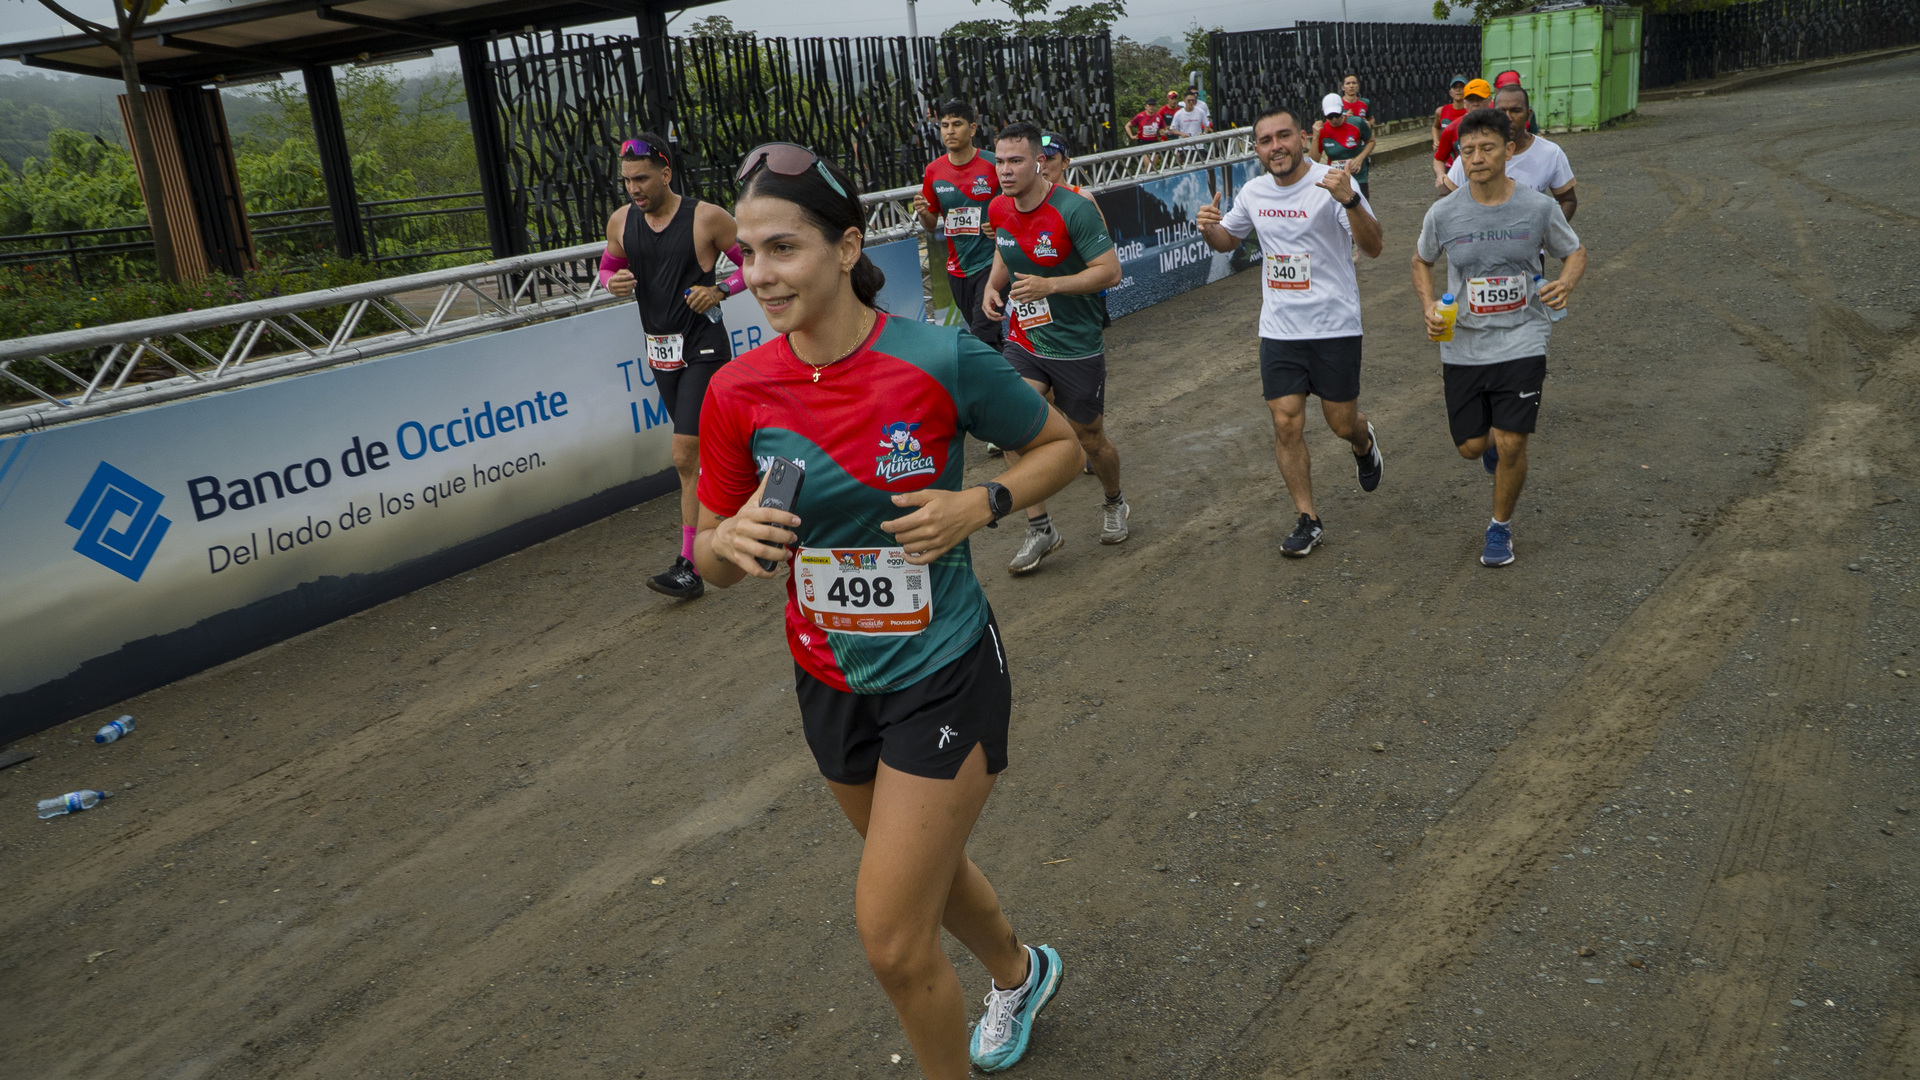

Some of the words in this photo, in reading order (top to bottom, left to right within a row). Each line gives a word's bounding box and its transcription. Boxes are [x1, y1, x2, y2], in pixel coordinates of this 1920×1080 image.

[1258, 209, 1308, 218] HONDA
[953, 216, 972, 227] 794
[1155, 226, 1170, 248] TU
[1487, 230, 1512, 240] RUN
[1159, 240, 1214, 273] IMPACTA.
[1273, 265, 1296, 279] 340
[1477, 288, 1519, 303] 1595
[654, 346, 674, 360] 781
[616, 357, 656, 392] TU
[187, 475, 332, 522] Banco
[341, 435, 391, 478] de
[396, 390, 569, 461] Occidente
[892, 454, 904, 463] La
[876, 455, 935, 479] Muñeca
[208, 531, 259, 575] Del
[267, 515, 332, 556] lado
[338, 501, 372, 531] de
[379, 491, 415, 518] los
[422, 476, 467, 508] que
[472, 452, 547, 488] hacen.
[886, 558, 905, 566] eggy
[827, 576, 895, 608] 498
